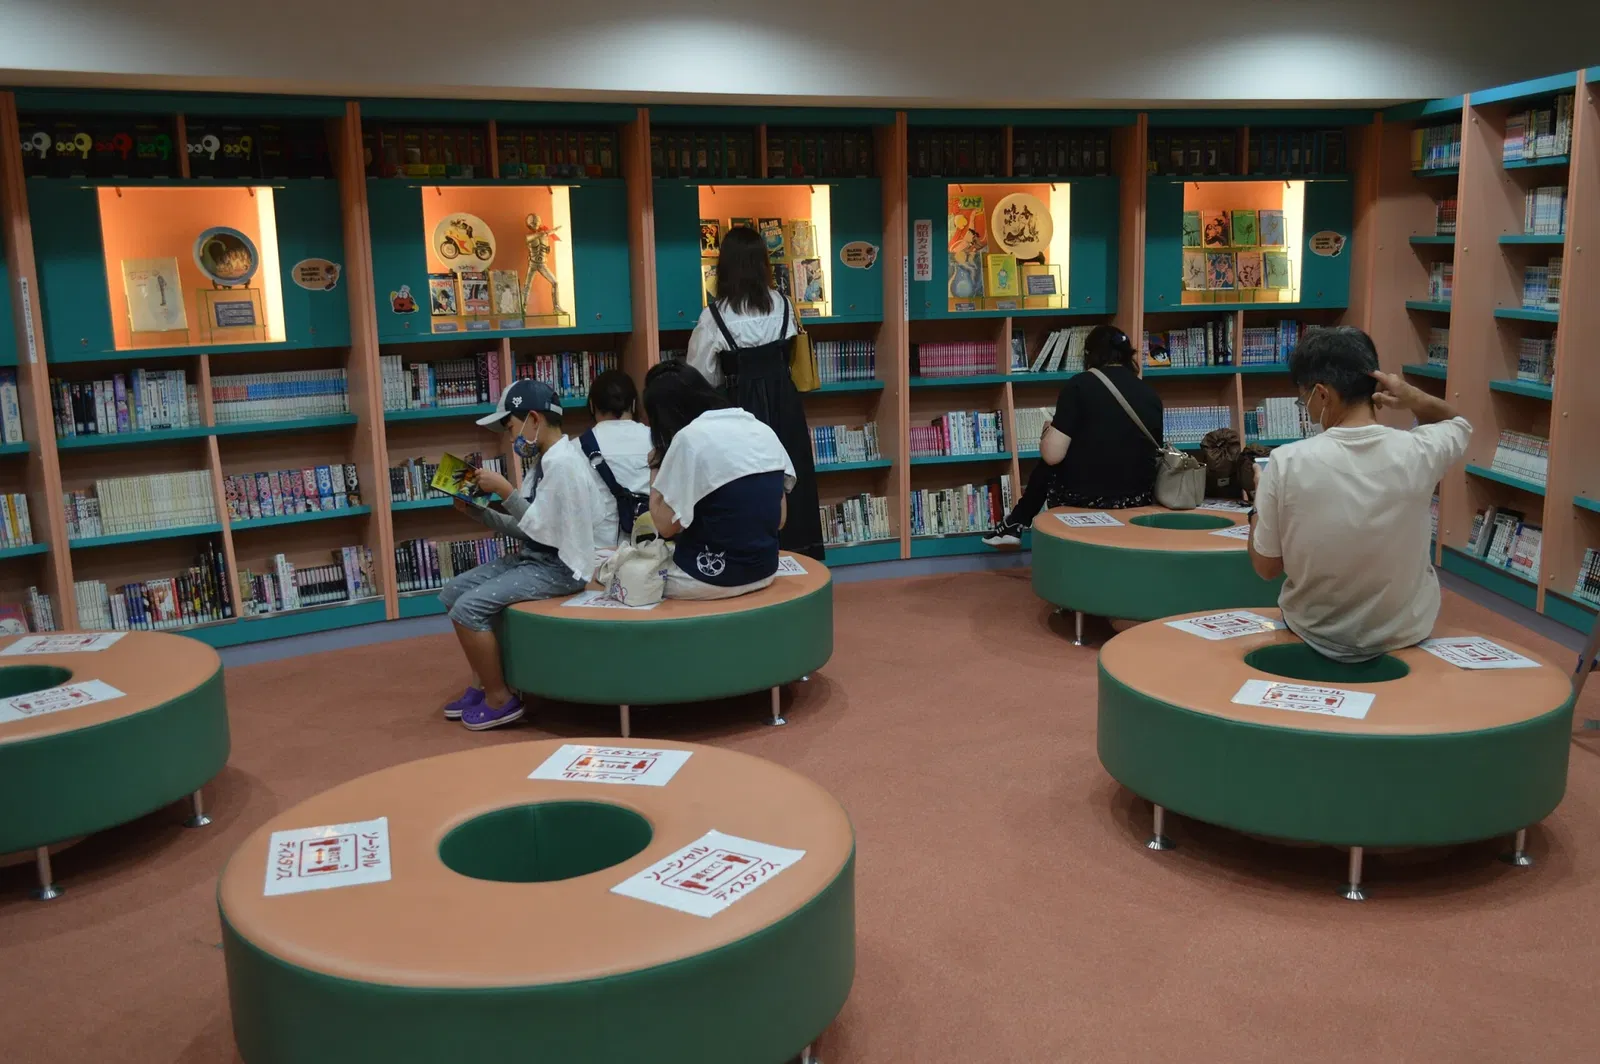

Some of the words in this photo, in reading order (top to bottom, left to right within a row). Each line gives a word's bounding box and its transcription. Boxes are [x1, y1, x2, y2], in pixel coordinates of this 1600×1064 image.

[916, 224, 930, 277] 防犯カメラ作動中
[643, 846, 710, 882] ソーシャル
[712, 860, 782, 901] ディスタンス
